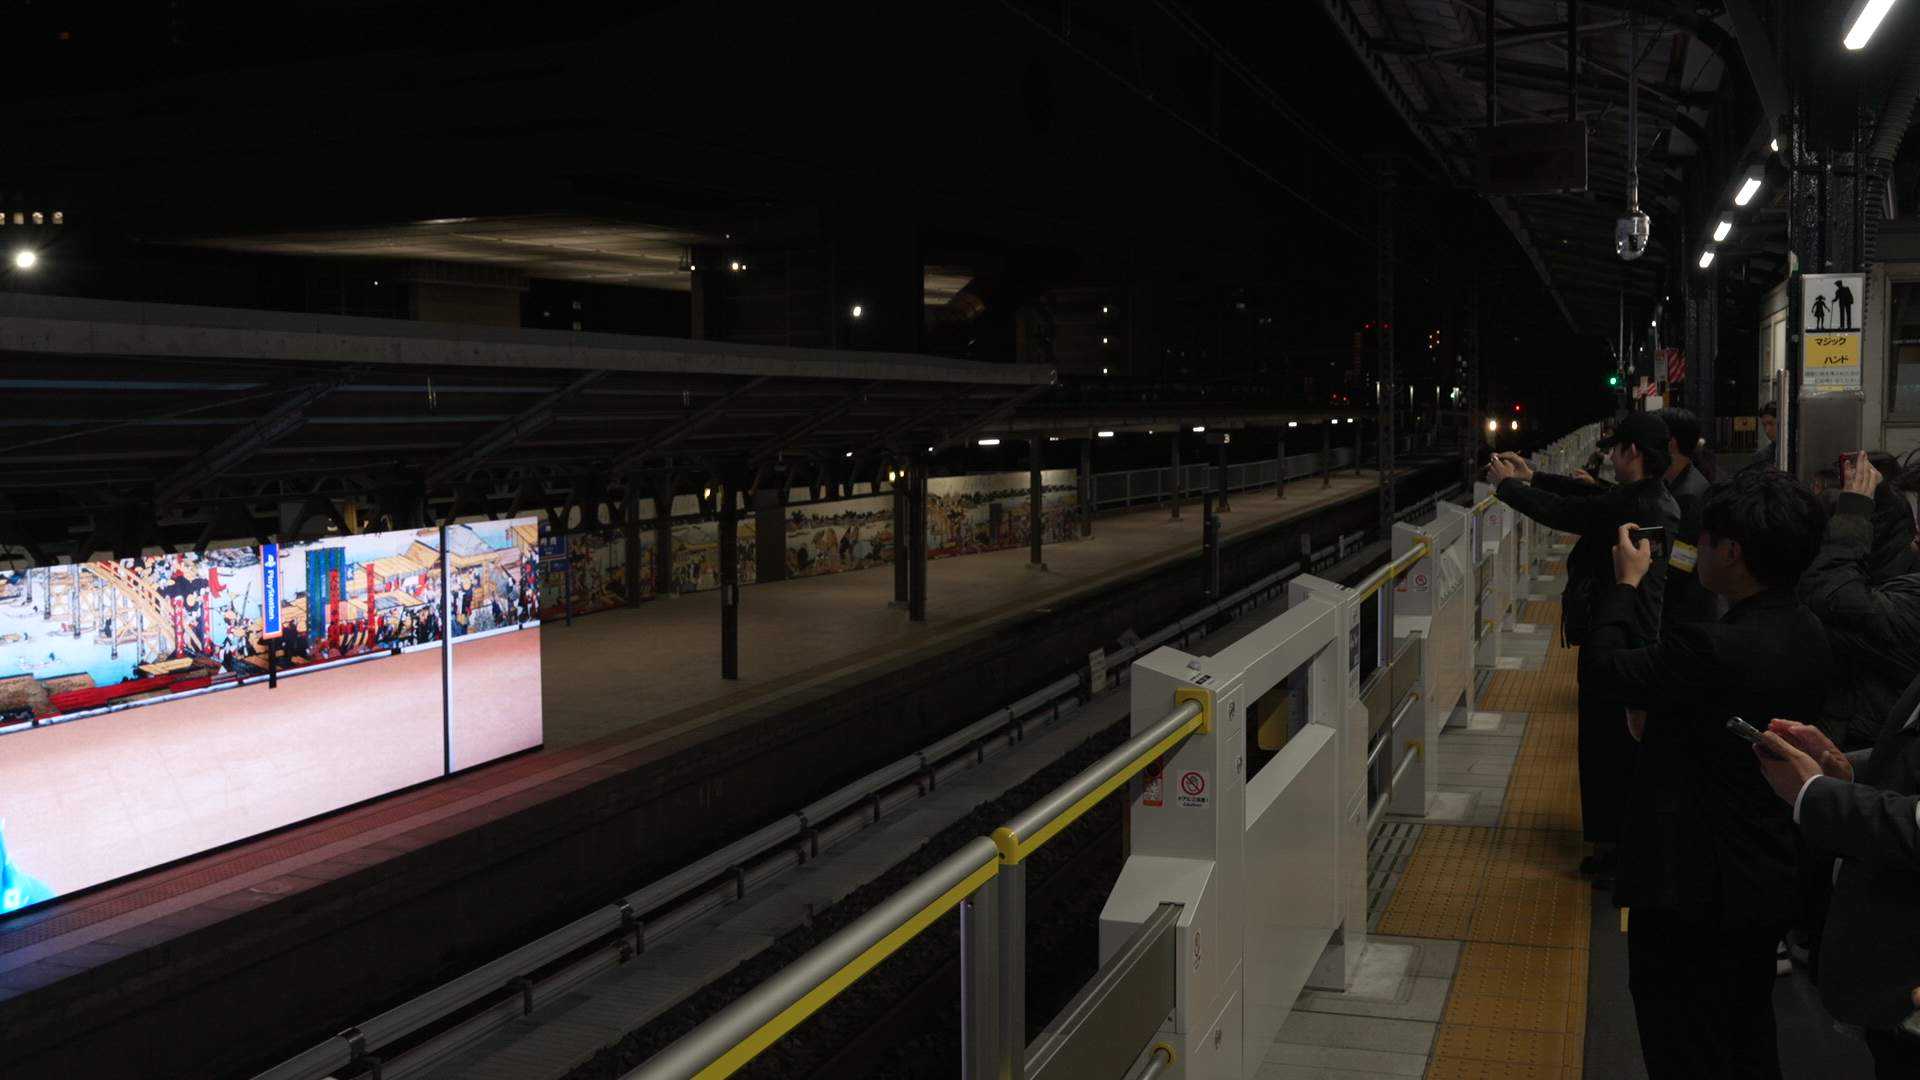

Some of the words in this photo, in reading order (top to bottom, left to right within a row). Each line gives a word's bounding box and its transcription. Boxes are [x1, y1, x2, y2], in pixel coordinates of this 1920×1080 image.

[1814, 337, 1847, 346] マジック
[1824, 355, 1849, 364] ハンド
[1223, 433, 1231, 444] 3
[265, 569, 275, 620] PlayStation
